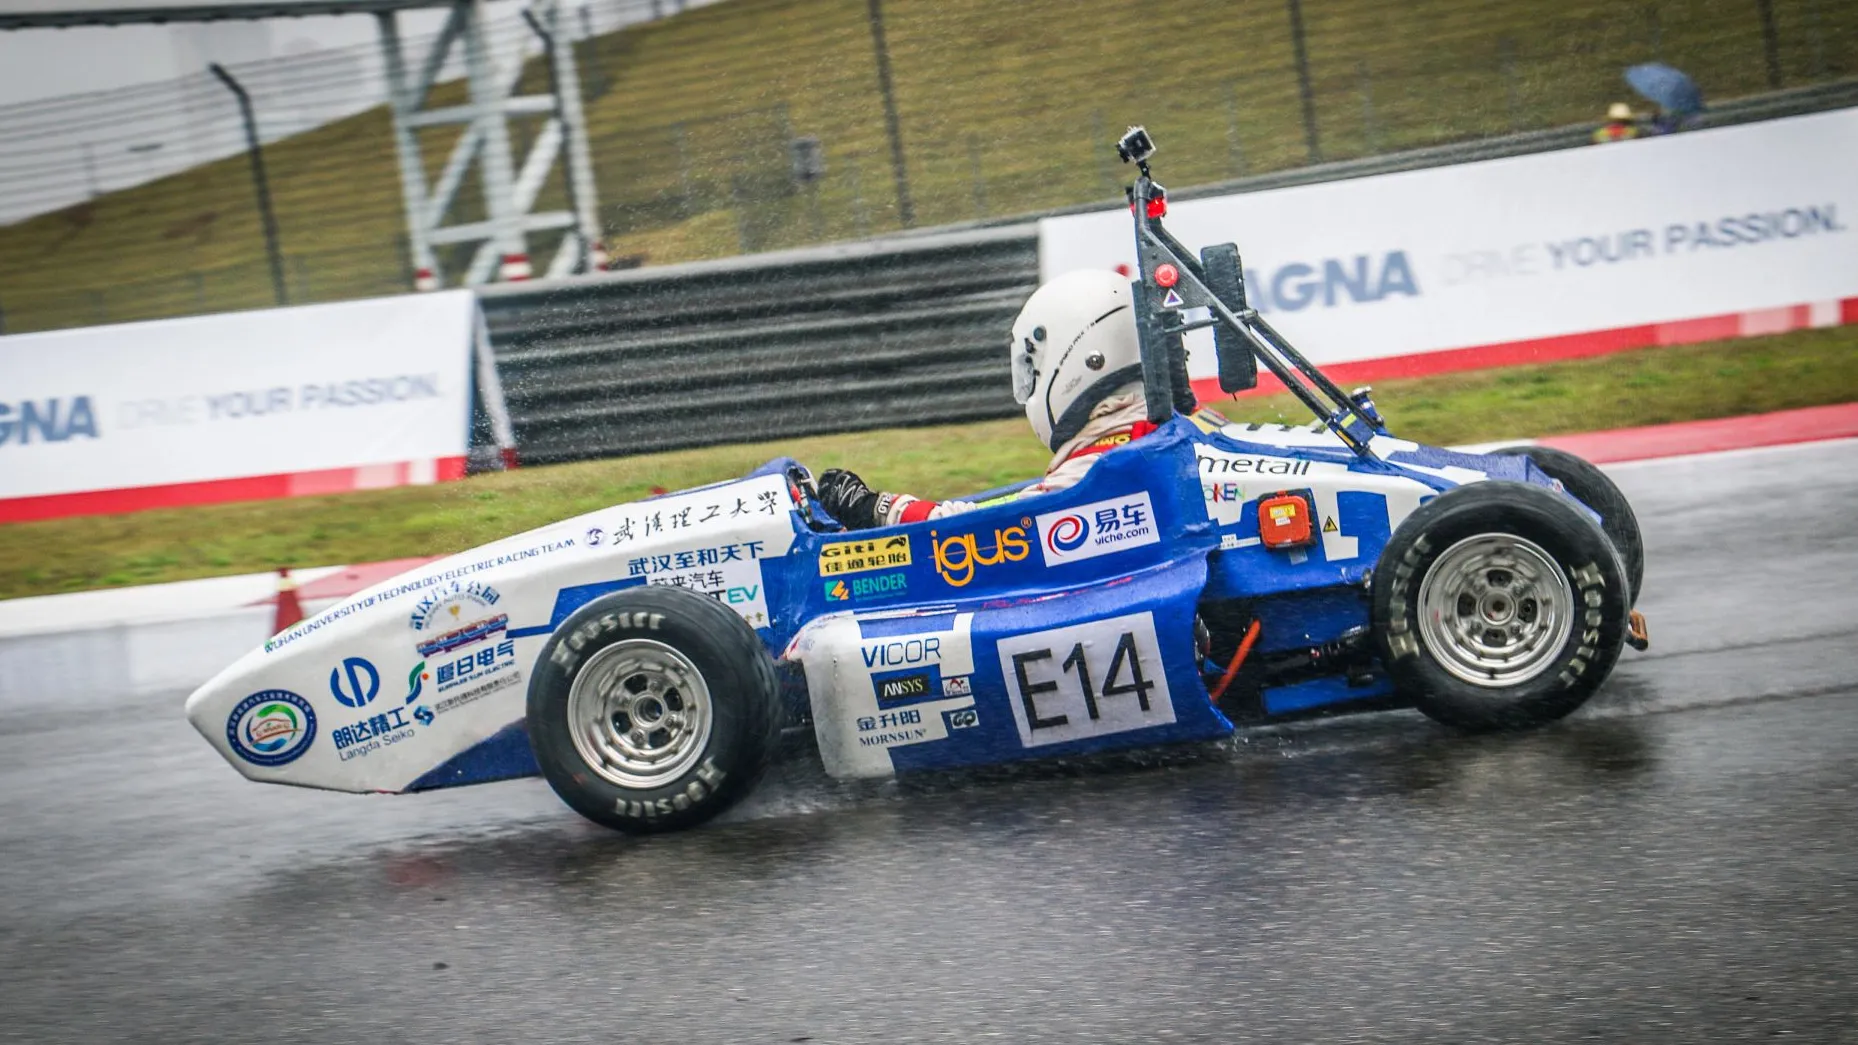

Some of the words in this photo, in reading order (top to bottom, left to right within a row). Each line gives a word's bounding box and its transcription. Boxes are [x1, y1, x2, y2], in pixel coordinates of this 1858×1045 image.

[1549, 227, 1654, 269] YOUR
[206, 386, 293, 421] YOUR
[1197, 454, 1311, 476] metall
[1094, 502, 1147, 533] 易车
[627, 540, 764, 576] 武汉至和天下
[825, 552, 907, 573] 佳通轮胎
[264, 628, 302, 653] WUHAN
[303, 601, 363, 636] UNIVERSITY
[363, 596, 378, 608] OF
[377, 573, 443, 601] TECHNOLOGY
[445, 559, 496, 580] ELECTRIC
[497, 548, 539, 566] RACING
[541, 538, 576, 554] TEAM
[702, 584, 758, 604] TEV
[852, 573, 908, 597] BENDER
[861, 637, 941, 668] VICOR
[884, 678, 923, 697] ANSYS
[1012, 631, 1154, 730] E14
[331, 706, 410, 750] 朗达精工
[856, 709, 921, 732] 金升阳
[339, 740, 381, 762] Langda
[382, 728, 415, 747] Seiko
